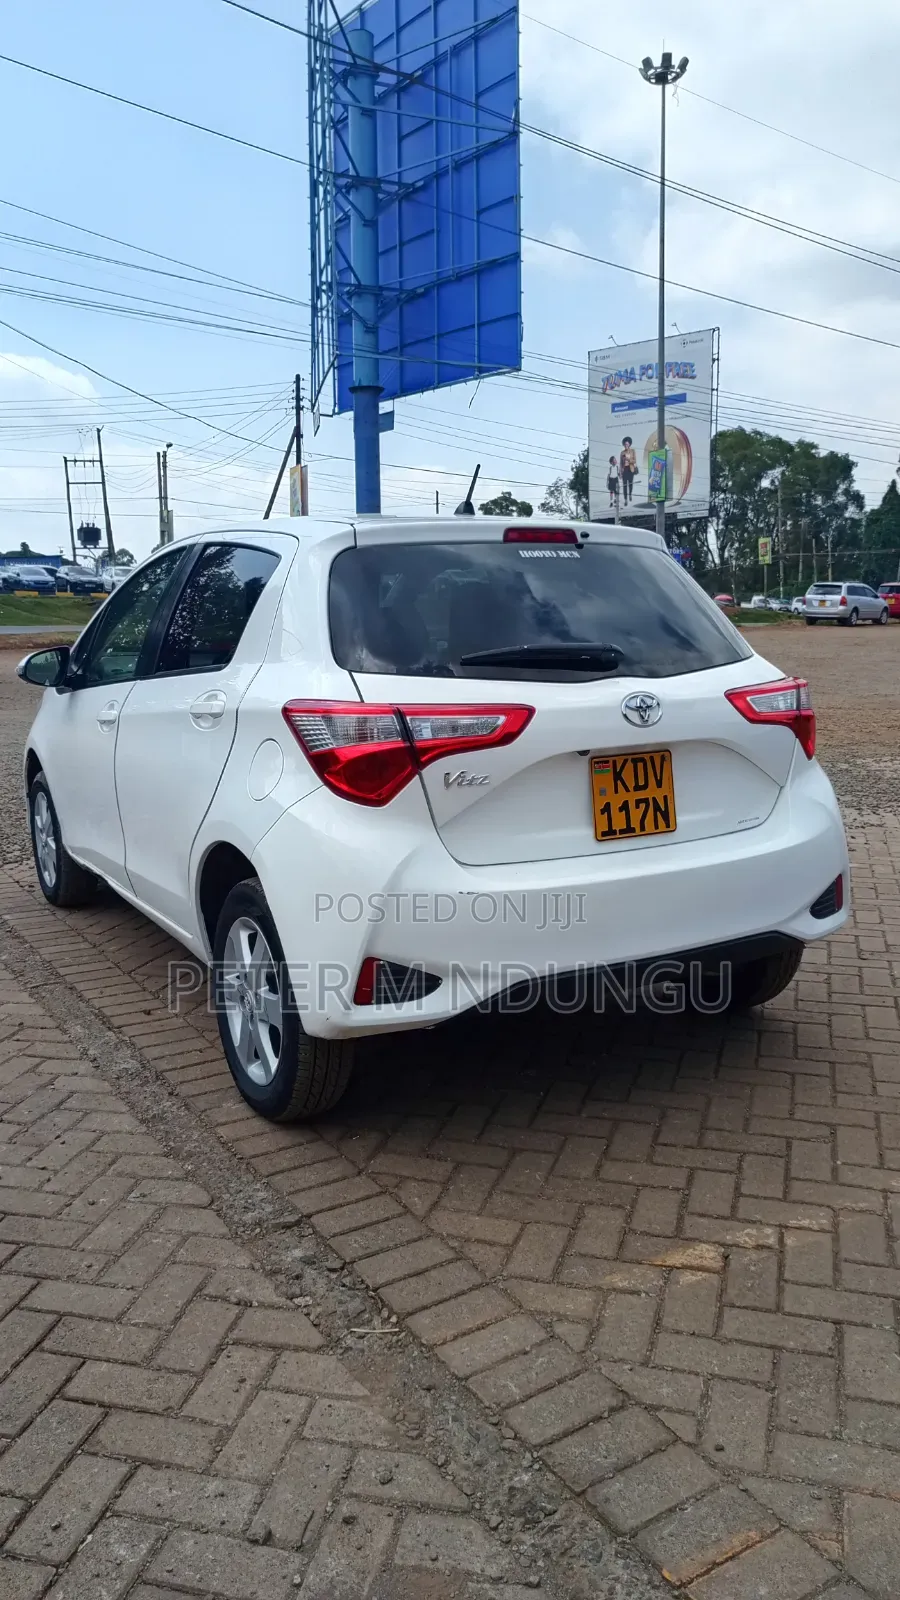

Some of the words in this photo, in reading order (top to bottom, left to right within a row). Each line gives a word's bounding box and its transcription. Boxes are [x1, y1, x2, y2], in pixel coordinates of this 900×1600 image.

[601, 366, 636, 393] TUMA
[664, 361, 697, 380] FREE
[443, 769, 490, 790] Vitz
[612, 754, 666, 794] KDV
[600, 794, 671, 838] 117N
